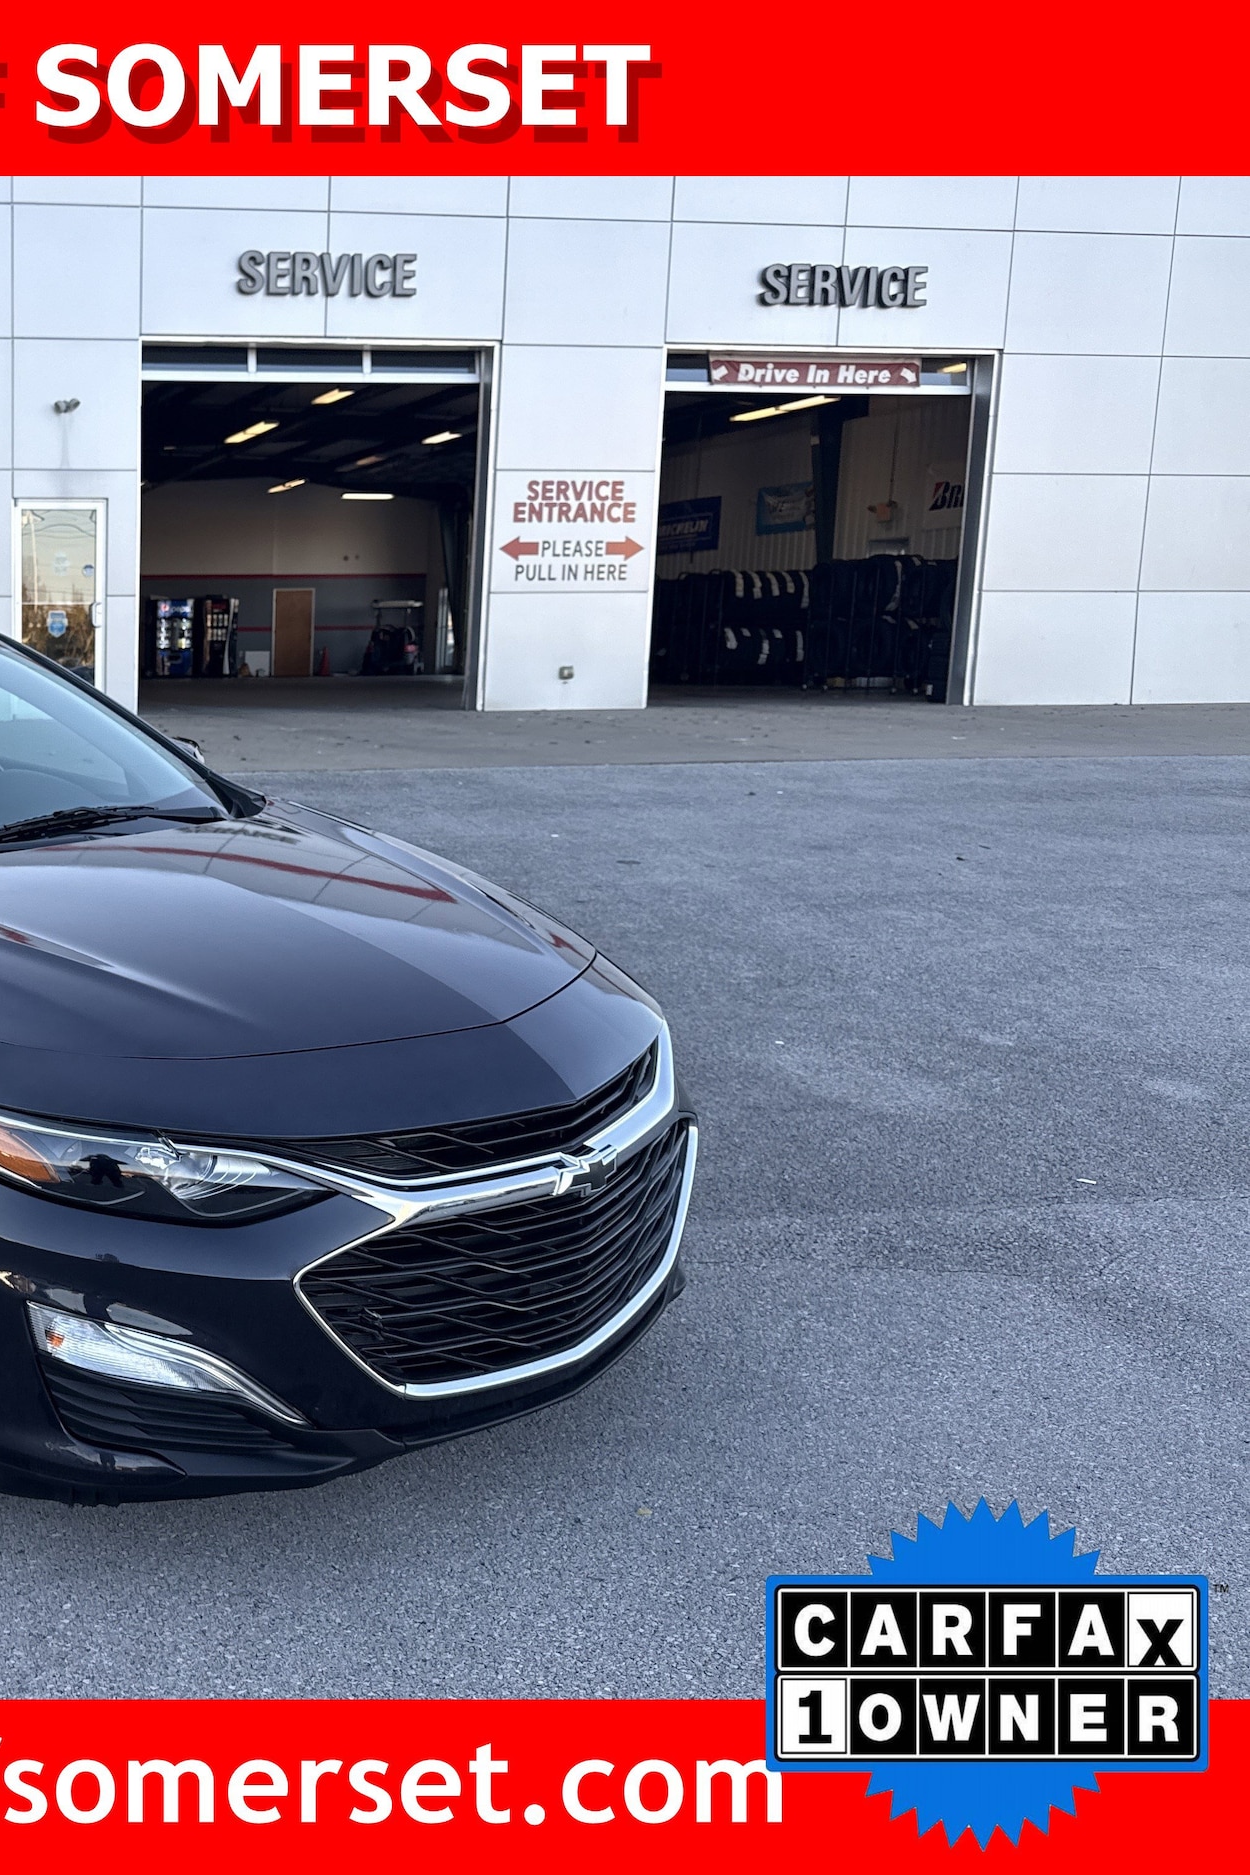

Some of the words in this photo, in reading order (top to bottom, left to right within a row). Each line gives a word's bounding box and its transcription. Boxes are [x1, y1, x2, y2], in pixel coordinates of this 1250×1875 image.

[237, 249, 417, 298] SERVICE
[756, 263, 928, 308] SERVICE
[737, 362, 800, 383] Drive
[806, 364, 828, 384] In
[837, 364, 891, 384] Here
[526, 480, 625, 501] SERVICE
[513, 502, 637, 523] ENTRANCE
[541, 540, 604, 558] PLEASE
[515, 564, 556, 582] PULL
[561, 564, 579, 581] IN
[584, 564, 627, 581] HERE
